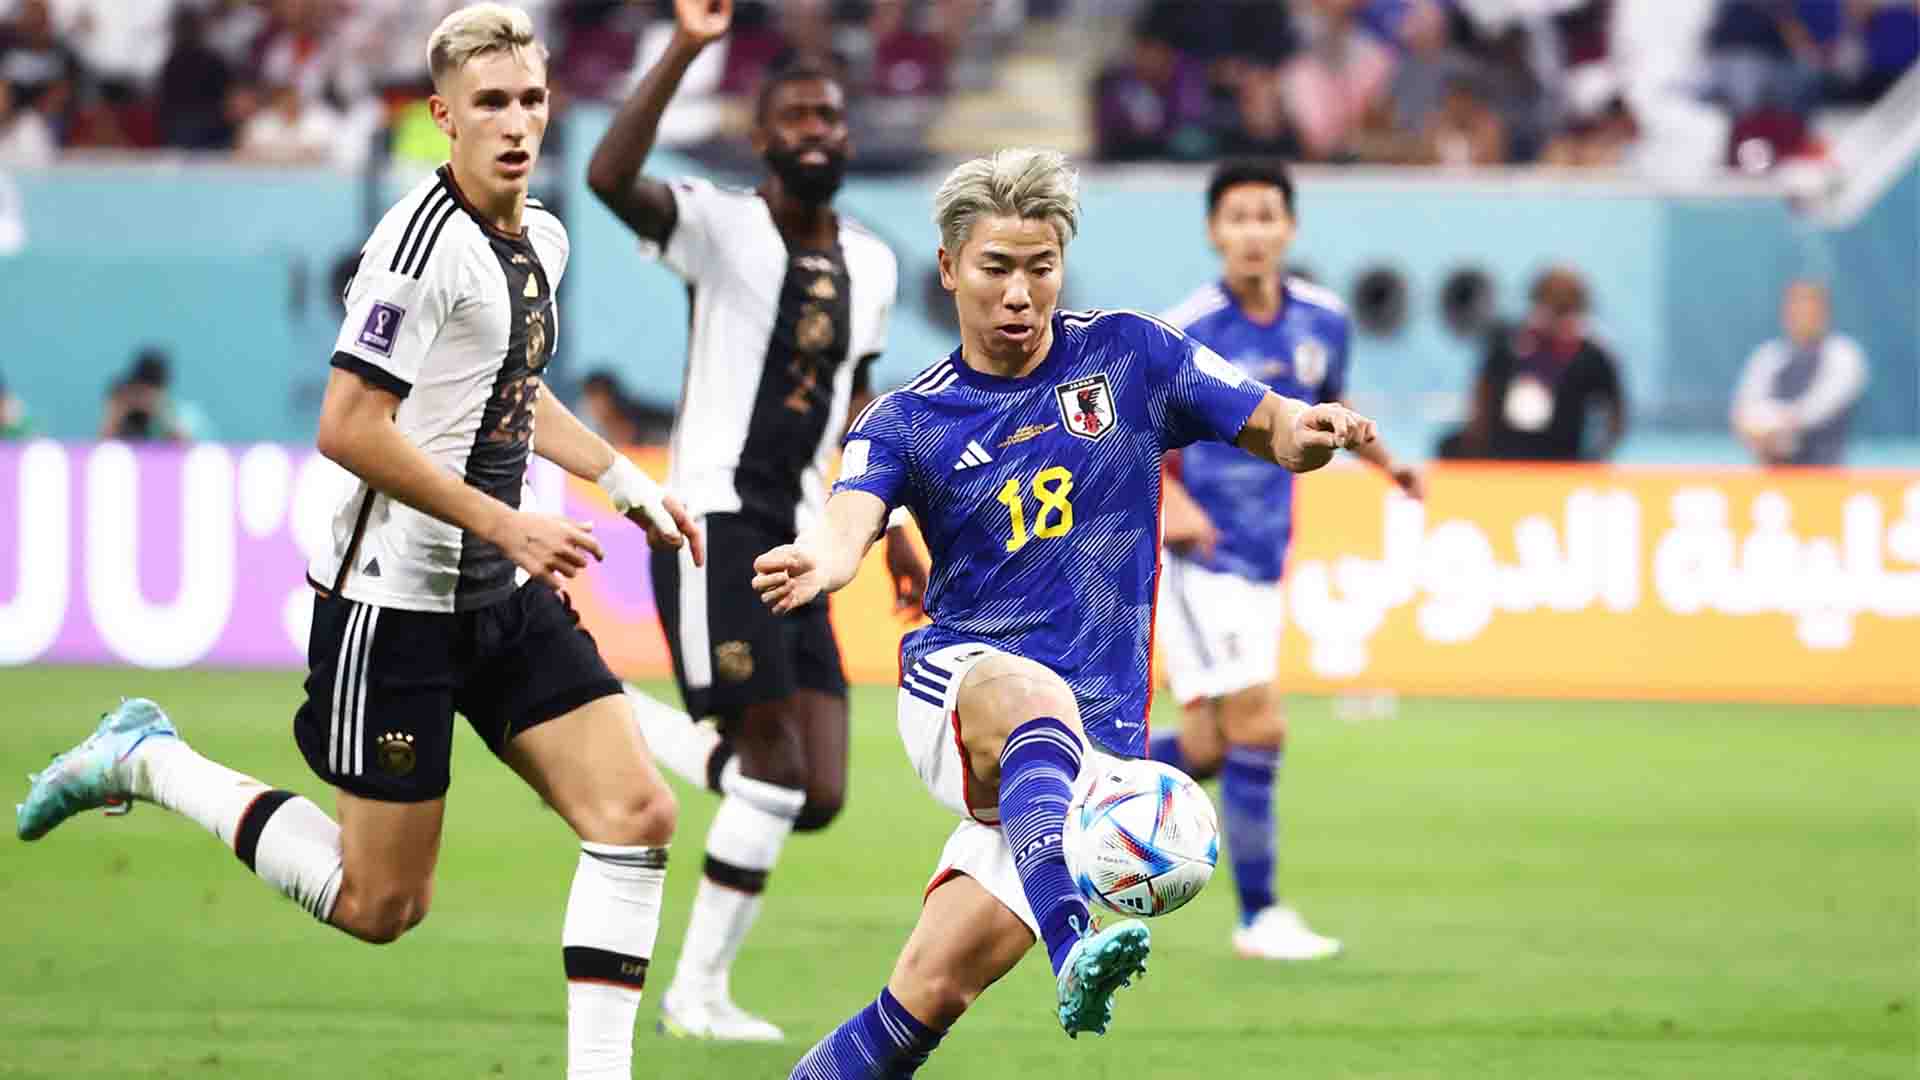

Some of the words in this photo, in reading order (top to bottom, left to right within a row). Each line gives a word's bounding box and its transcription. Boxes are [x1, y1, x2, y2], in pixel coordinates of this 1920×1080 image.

[1068, 378, 1096, 391] JAPAN
[996, 465, 1074, 553] 18
[1290, 486, 1638, 678] الدولي
[1016, 832, 1062, 867] JAP
